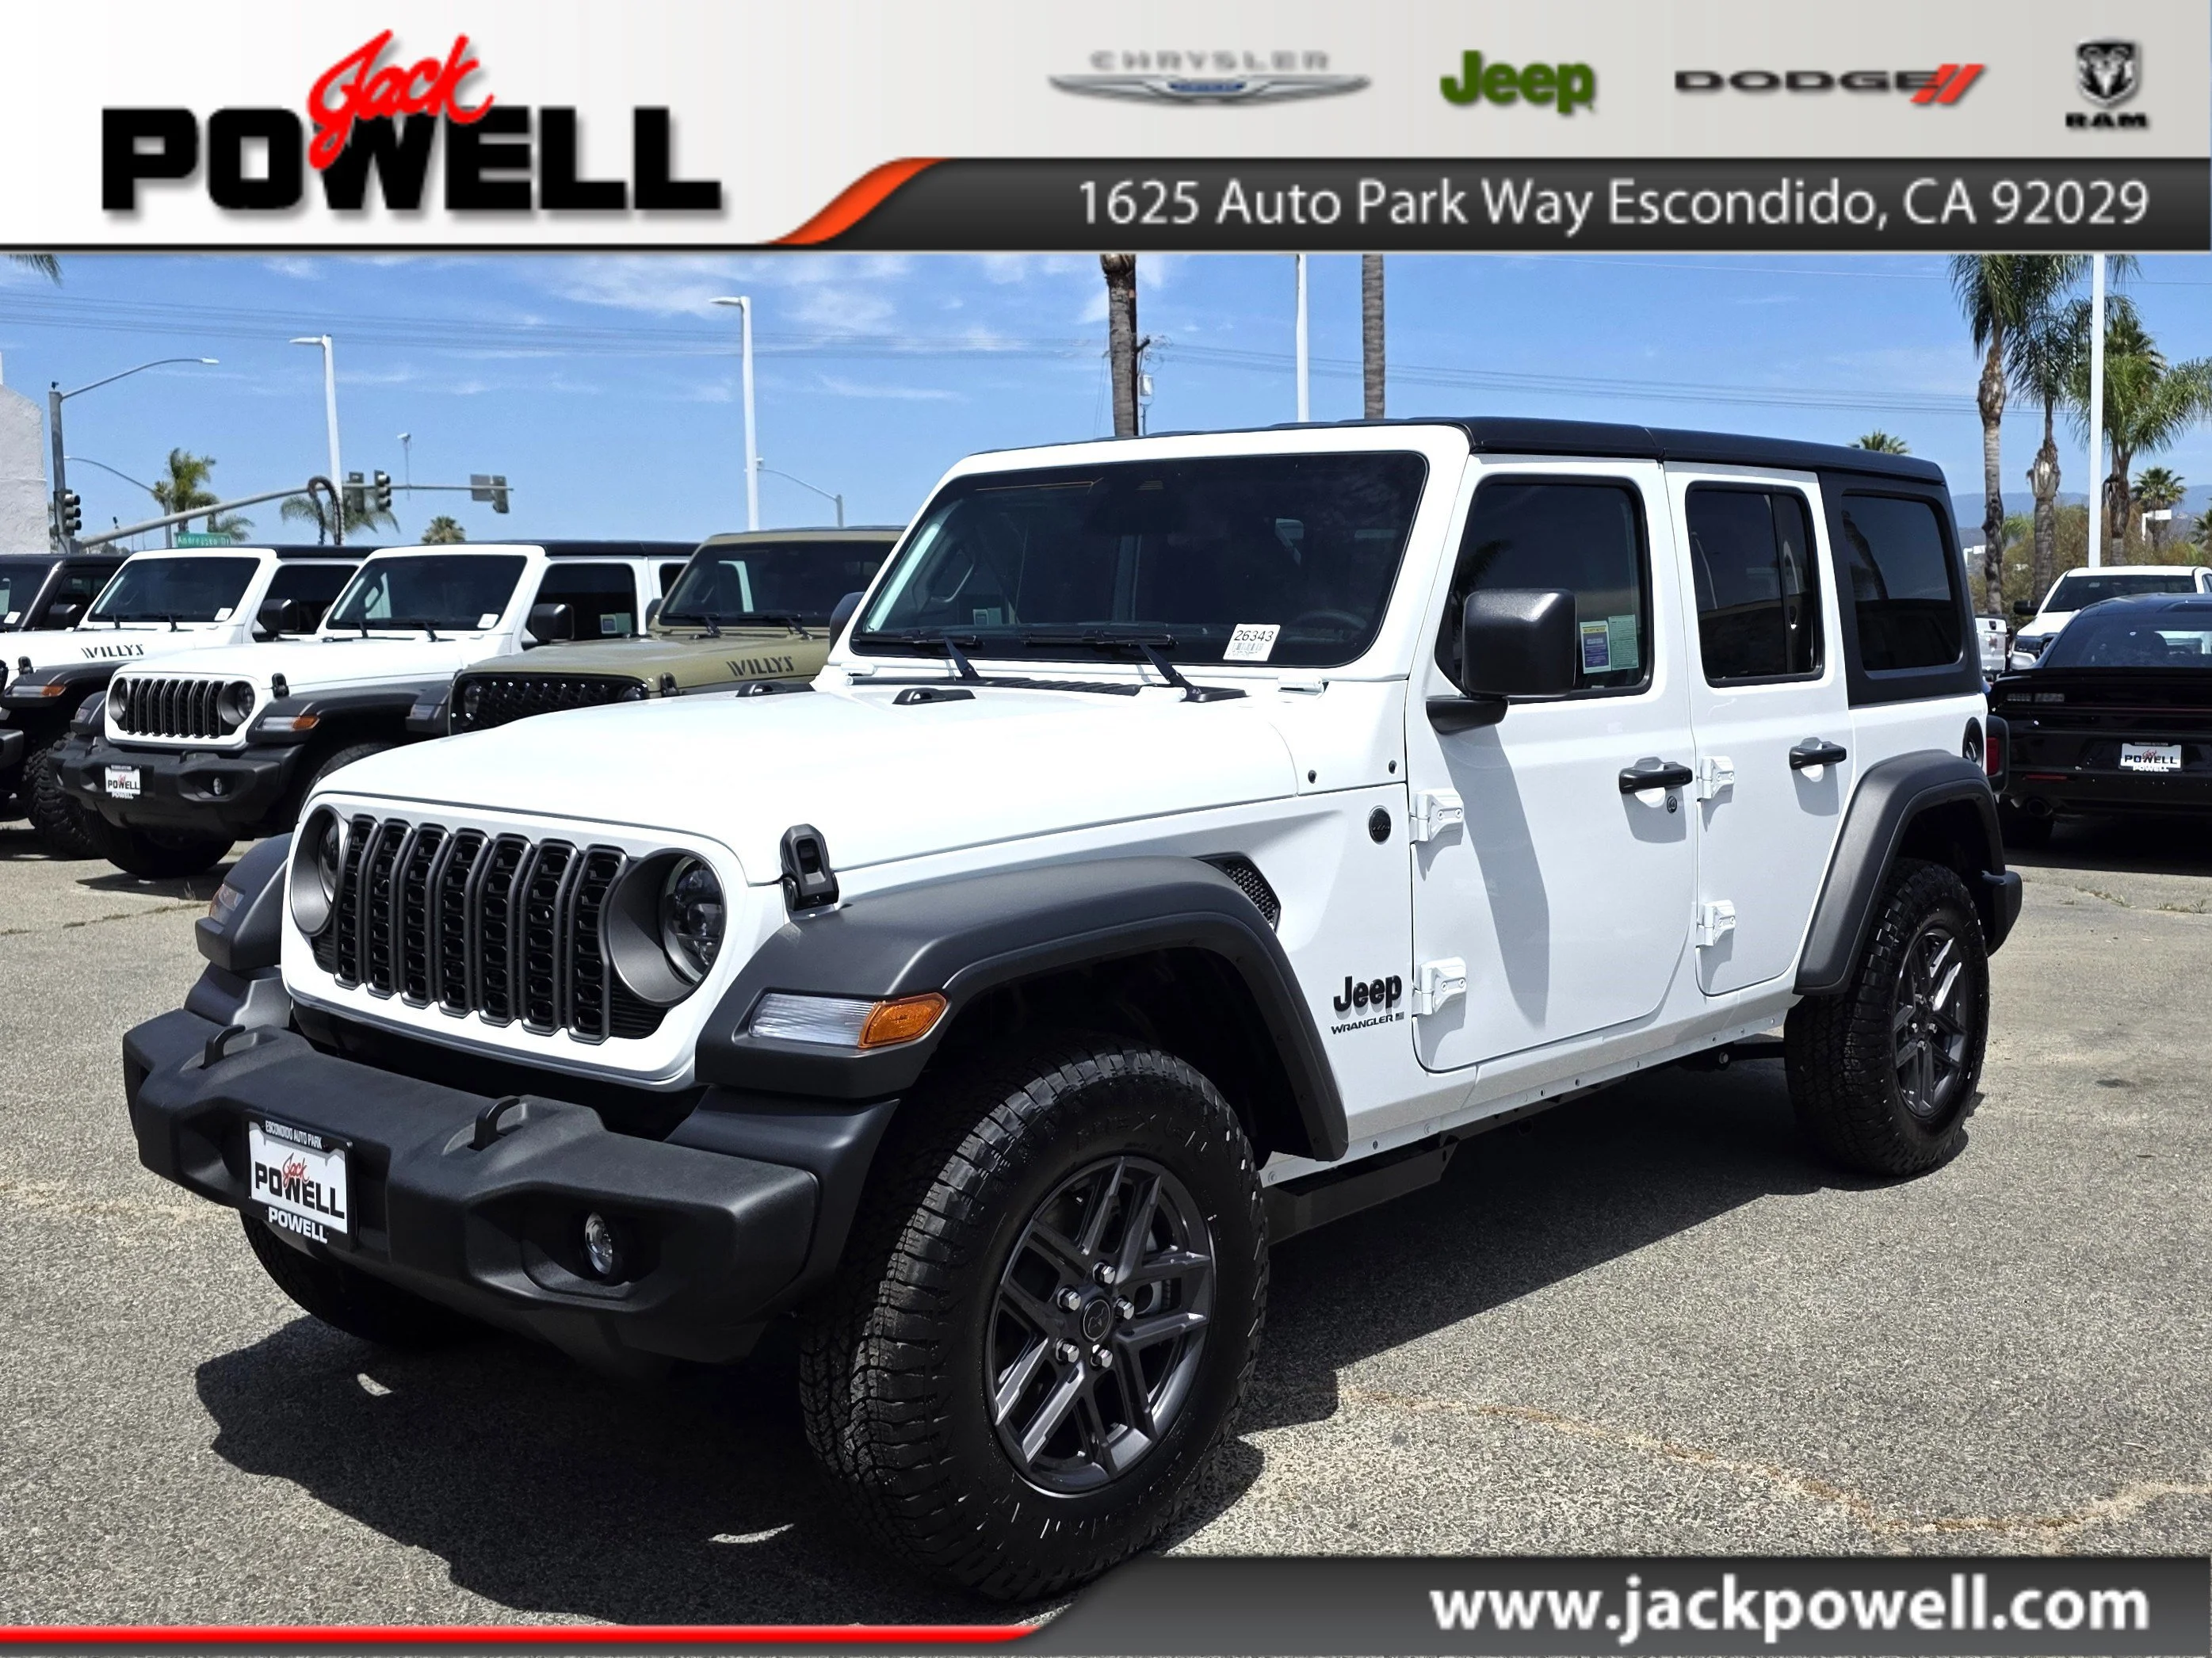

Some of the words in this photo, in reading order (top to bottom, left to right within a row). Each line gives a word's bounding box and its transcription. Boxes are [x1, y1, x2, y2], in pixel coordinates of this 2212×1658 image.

[1233, 629, 1274, 642] 26343
[80, 644, 144, 659] WILLYS
[725, 655, 794, 677] WILLYS
[2124, 755, 2177, 764] POWELL
[107, 779, 140, 790] POWELL
[1333, 975, 1403, 1012] Jeep
[1331, 1014, 1393, 1034] WRANGLER
[265, 1120, 293, 1140] ESCONDIDO
[293, 1129, 308, 1144] AUTO
[308, 1133, 323, 1149] PARK
[282, 1152, 310, 1188] Jack
[254, 1161, 346, 1220] POWELL
[268, 1206, 328, 1244] POWELL
